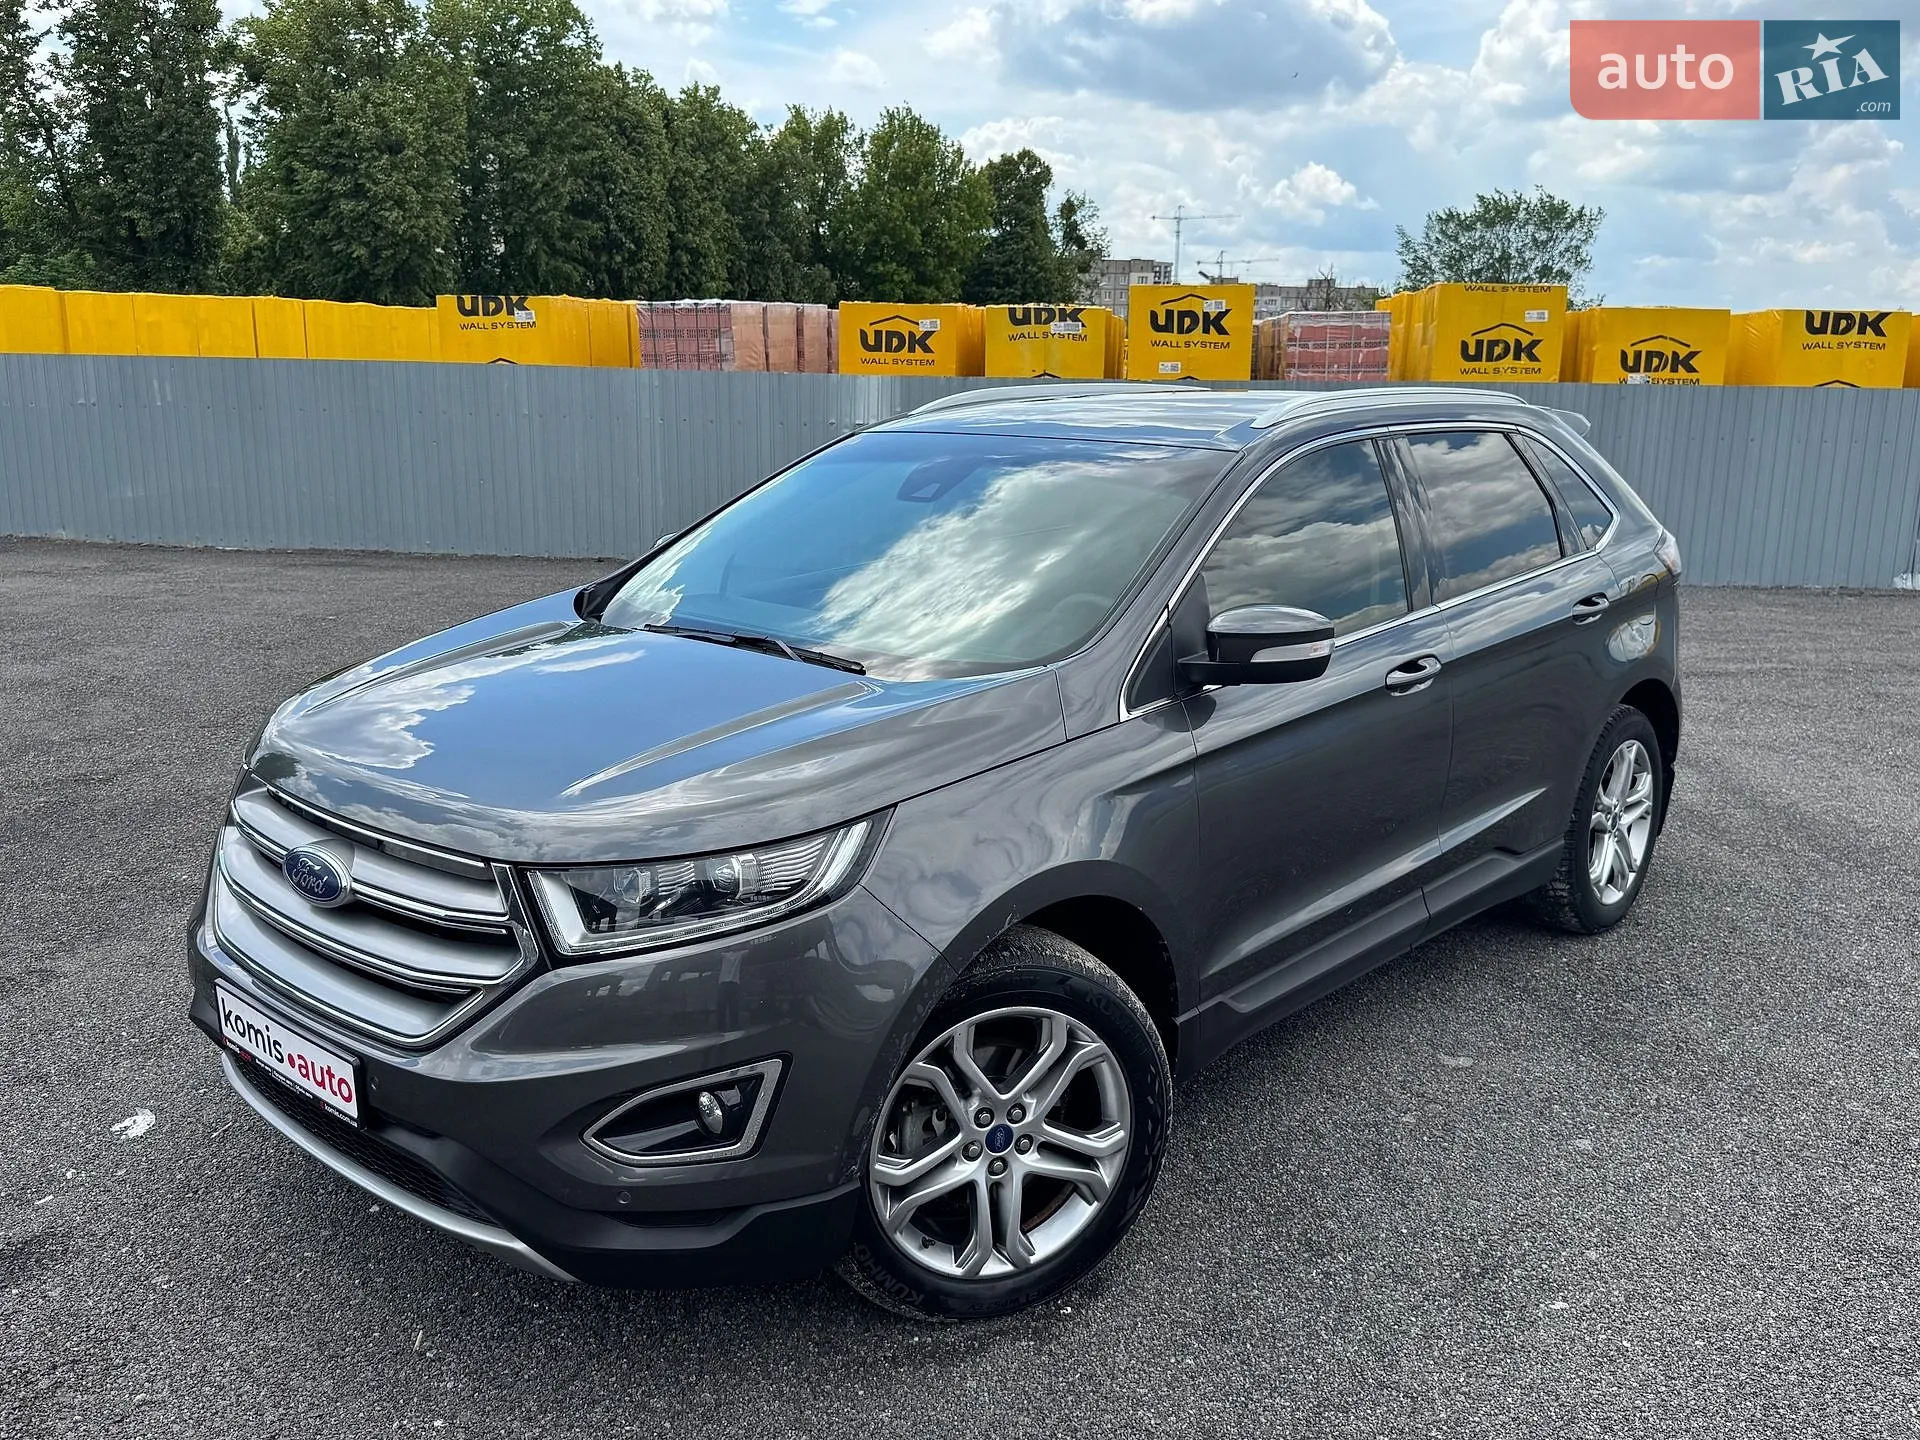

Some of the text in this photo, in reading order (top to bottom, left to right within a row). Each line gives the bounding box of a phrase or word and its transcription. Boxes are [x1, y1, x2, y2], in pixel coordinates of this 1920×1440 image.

[1464, 285, 1551, 293] WALL SYSTEM
[456, 295, 530, 318] UDK
[459, 320, 537, 331] WALL SYSTEM
[1008, 307, 1087, 329] UDK
[1150, 308, 1232, 336] UDK
[1804, 310, 1892, 337] UDK
[859, 328, 936, 354] UDK
[1008, 330, 1088, 343] WALL SYSTEM
[1150, 340, 1230, 350] WALL SYSTEM
[1460, 338, 1544, 363] UDK
[1802, 341, 1886, 351] WALL SYSTEM
[860, 358, 936, 367] WALL SYSTEM
[1619, 349, 1702, 374] UDK
[1460, 366, 1541, 375] WALL SYSTEM
[1651, 377, 1700, 385] SYSTEM
[291, 856, 329, 895] Ford
